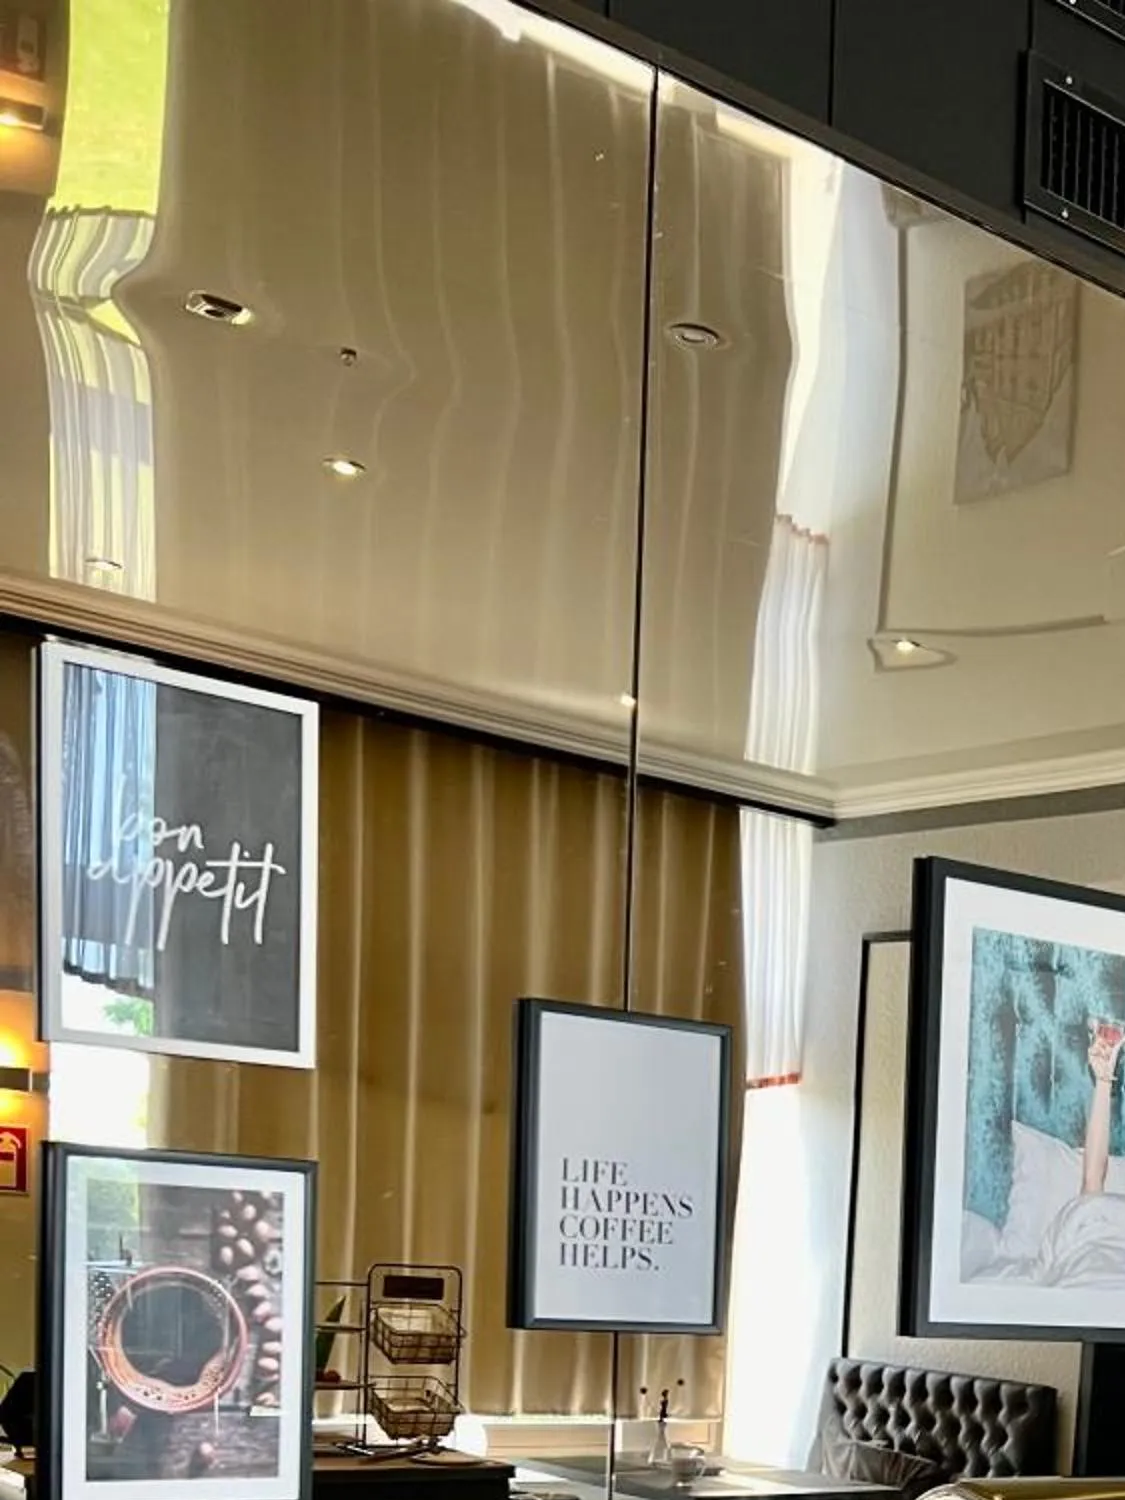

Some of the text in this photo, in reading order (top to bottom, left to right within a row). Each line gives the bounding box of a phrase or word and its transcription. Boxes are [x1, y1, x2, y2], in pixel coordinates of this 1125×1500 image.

[112, 772, 205, 854] bon
[86, 842, 286, 951] appetit
[562, 1157, 628, 1187] LIFE
[561, 1186, 694, 1217] HAPPENS
[559, 1214, 673, 1245] COFFEE
[560, 1242, 660, 1272] HELPS.
